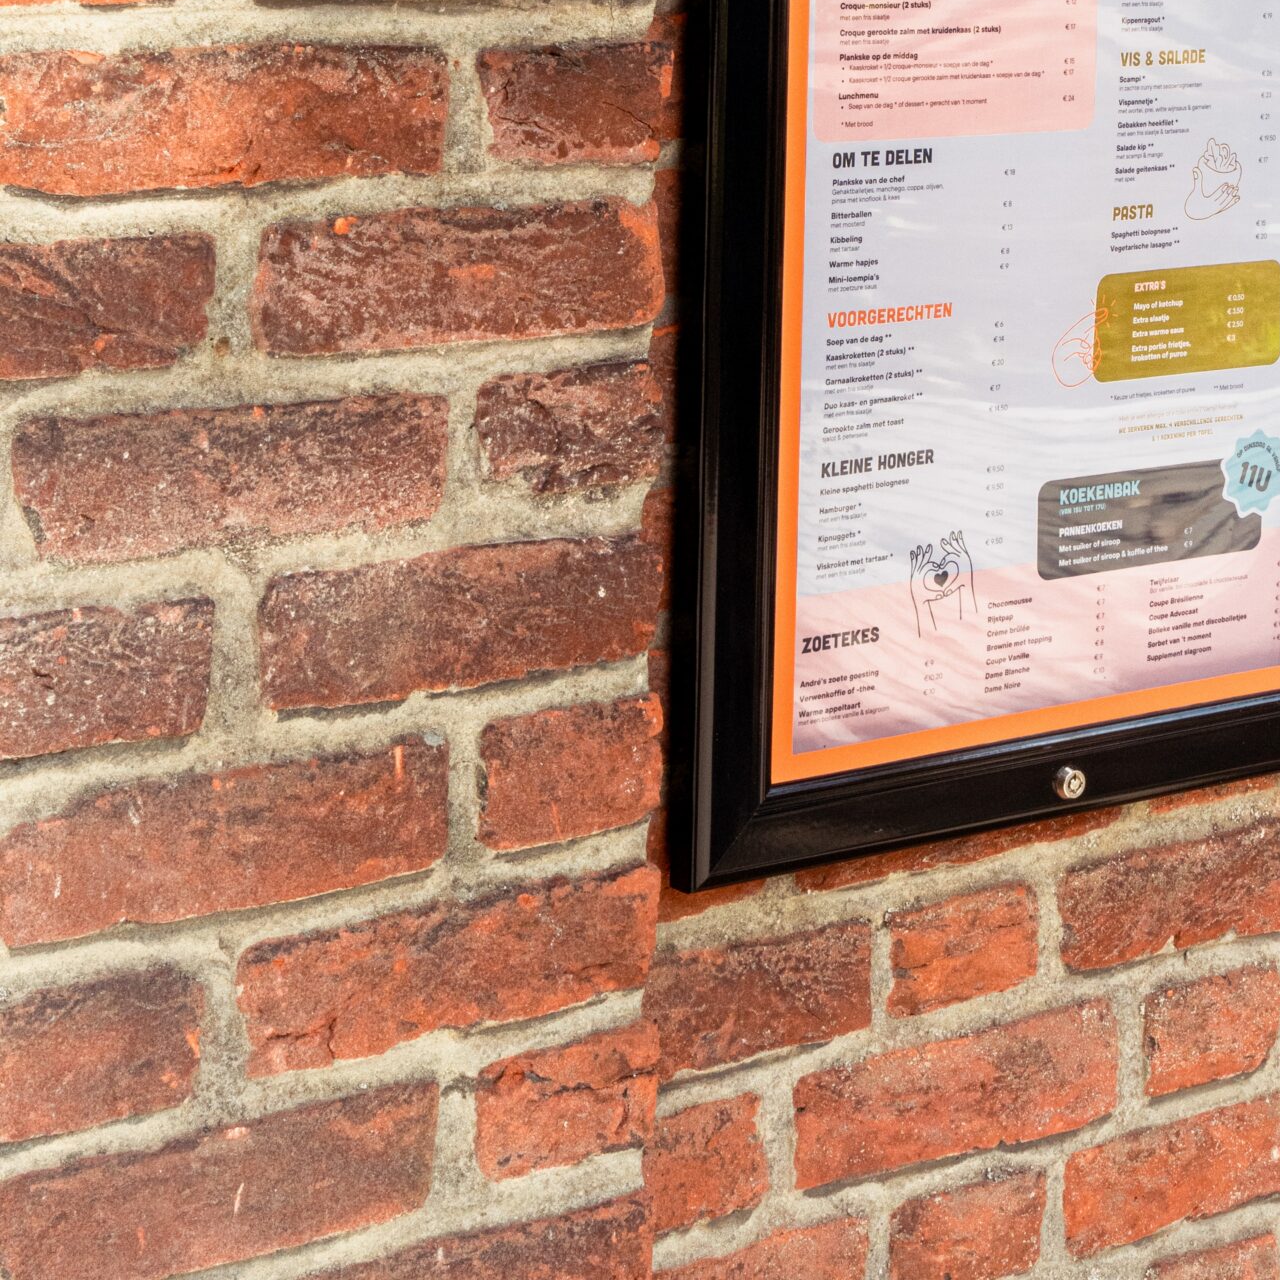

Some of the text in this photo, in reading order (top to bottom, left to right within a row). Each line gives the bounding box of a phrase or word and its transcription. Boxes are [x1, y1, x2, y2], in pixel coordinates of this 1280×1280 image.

[840, 1, 931, 12] Croque-monsieur (2 stuks)
[1122, 17, 1160, 25] Kippenragout
[840, 28, 865, 37] Croque
[867, 27, 898, 37] gerookte
[900, 27, 915, 35] zalm
[932, 26, 971, 34] kruidenkaas
[981, 25, 1001, 33] stuks)
[840, 53, 870, 61] Plankske
[872, 54, 880, 62] op
[893, 52, 918, 61] middag
[1121, 49, 1206, 67] VIS & SALADE
[839, 92, 878, 100] Lunchmenu
[1119, 98, 1153, 106] Vispannetje
[1117, 143, 1146, 152] Salade kip
[833, 148, 932, 168] OM TE DELEN
[1136, 166, 1167, 174] geitenkaas
[833, 178, 863, 186] Plankske
[831, 211, 872, 220] Bitterballen
[1113, 204, 1153, 221] PASTA
[1111, 228, 1170, 238] Spaghetti bolognese
[830, 235, 863, 244] Kibbeling
[1110, 241, 1172, 252] Vegetarische lasagne
[829, 259, 878, 268] Warme hapjes
[829, 274, 879, 284] Mini-loempia's
[1135, 281, 1166, 292] EXTRA'S
[1134, 302, 1149, 311] Mayo
[1159, 300, 1183, 308] ketchup
[828, 303, 952, 328] VOORGERECHTEN
[826, 339, 844, 347] Soep
[870, 335, 883, 343] dag
[826, 350, 875, 361] Kaaskroketten
[886, 347, 906, 356] stuks)
[826, 373, 884, 385] Garnaalkroketten
[894, 369, 914, 378] stuks)
[821, 449, 934, 478] KLEINE HONGER
[1239, 461, 1272, 492] 11U
[820, 478, 909, 496] Kleine spaghetti bolognese
[1060, 480, 1141, 505] KOEKENBAK
[819, 503, 856, 515] Hamburger
[1059, 520, 1122, 538] PANNENKOEKEN
[818, 531, 856, 543] Kipnuggets
[1059, 545, 1071, 553] Met
[1073, 542, 1091, 551] suiker
[817, 554, 888, 571] Viskroket met tartaar
[988, 597, 1032, 609] Chocomousse
[1170, 608, 1198, 617] Advocaat
[802, 627, 879, 654] ZOETEKES
[1147, 650, 1182, 661] Supplement
[800, 670, 879, 688] André's zoete goesting
